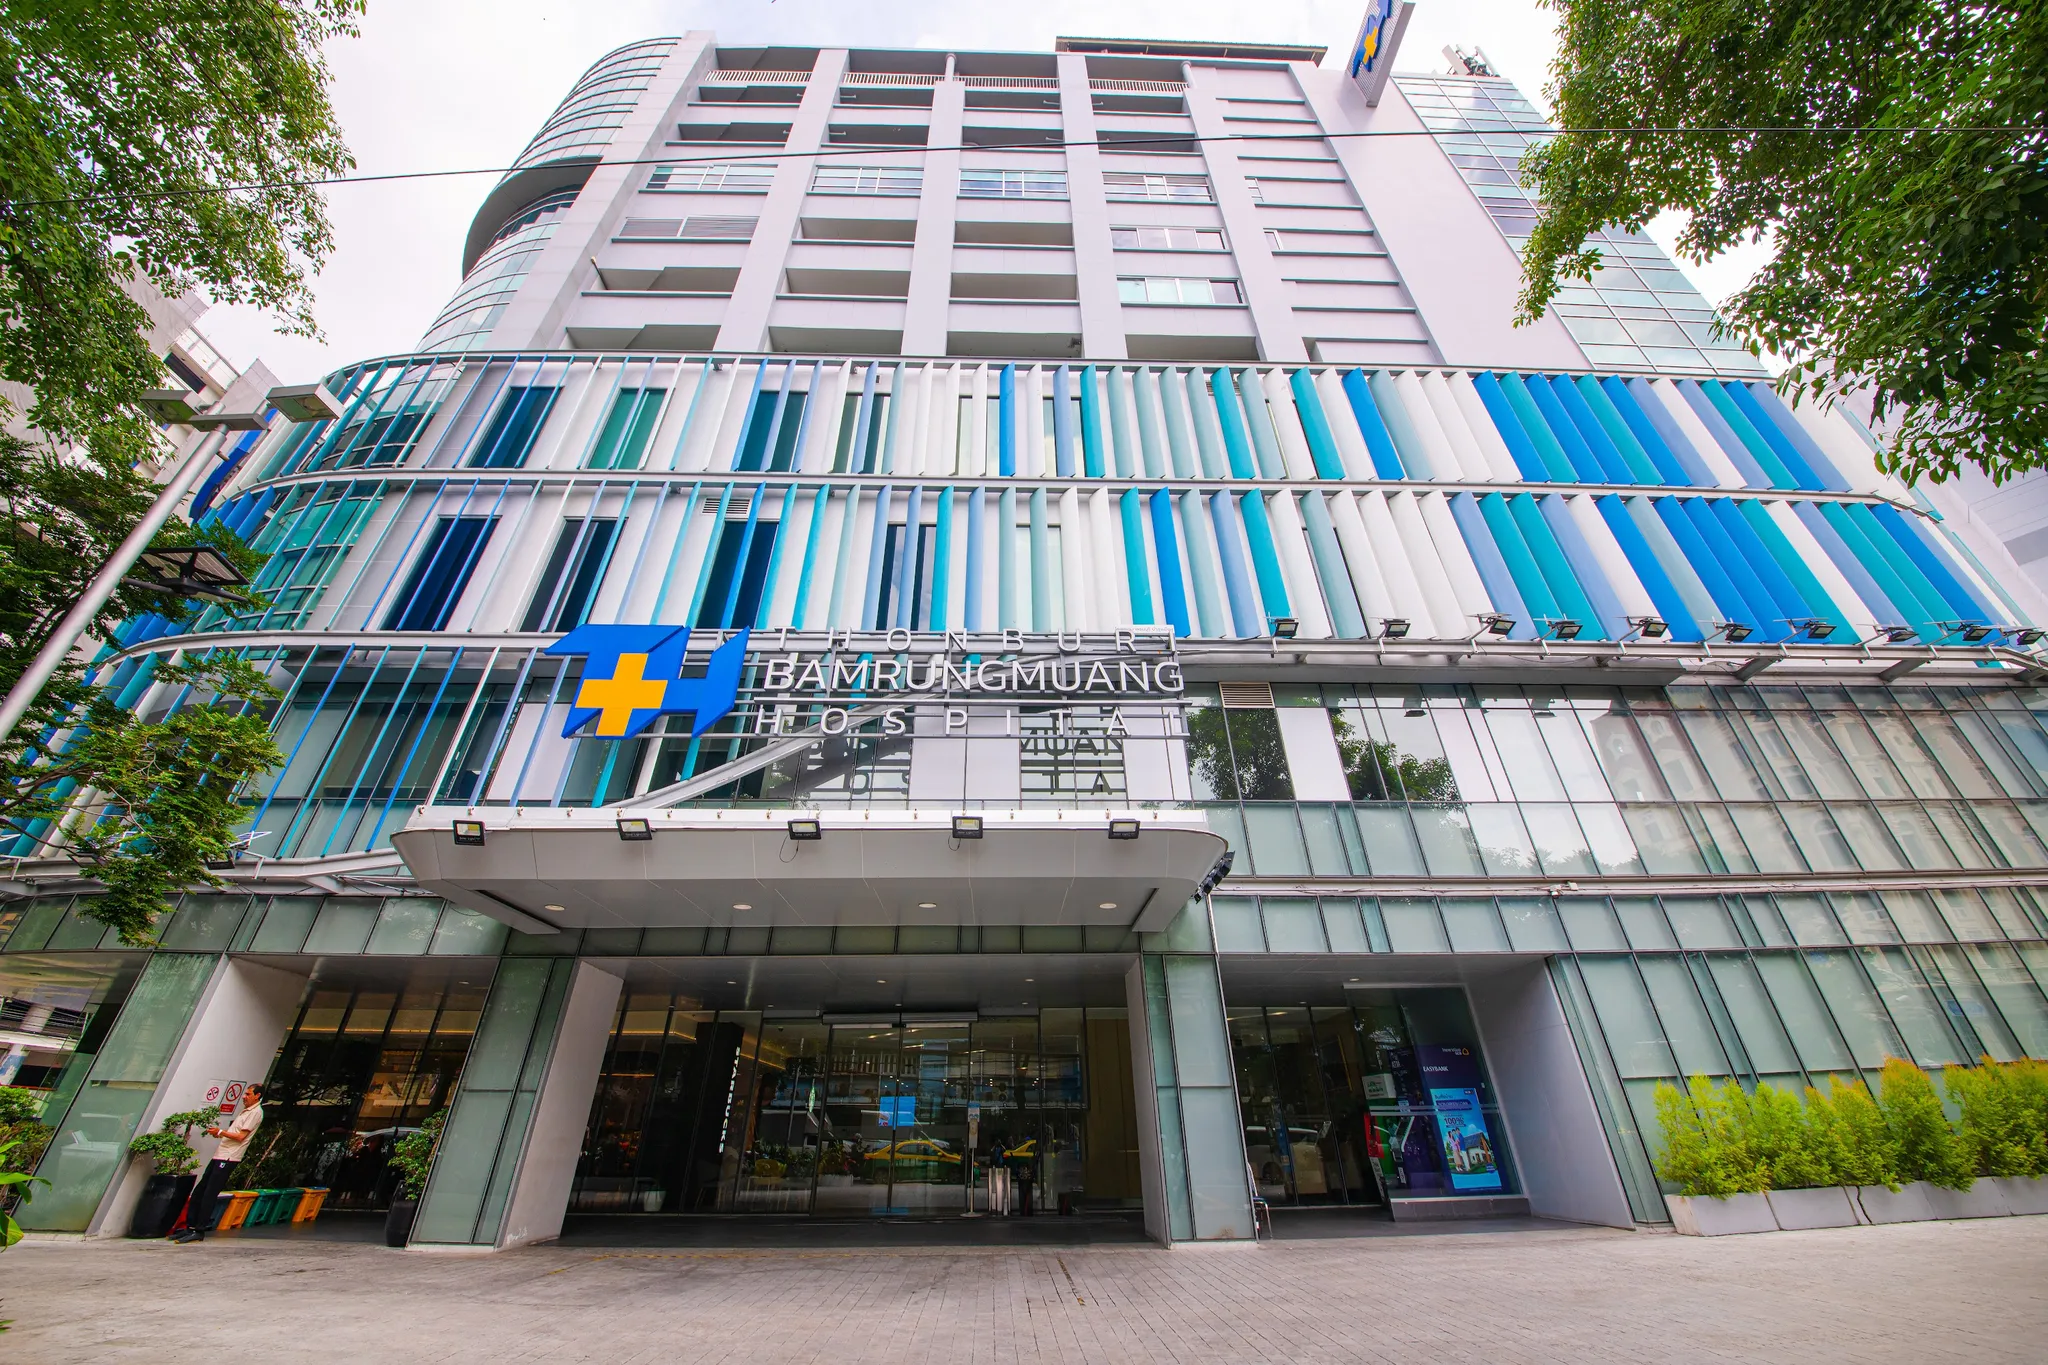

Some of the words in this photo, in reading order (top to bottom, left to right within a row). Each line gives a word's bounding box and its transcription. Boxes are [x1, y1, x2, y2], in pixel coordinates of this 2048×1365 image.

[774, 626, 1176, 652] THONBURI
[764, 659, 1184, 693] BAMRUNGMUANG
[755, 707, 1190, 736] HOSPITAL
[719, 1046, 740, 1153] STARBUCKS
